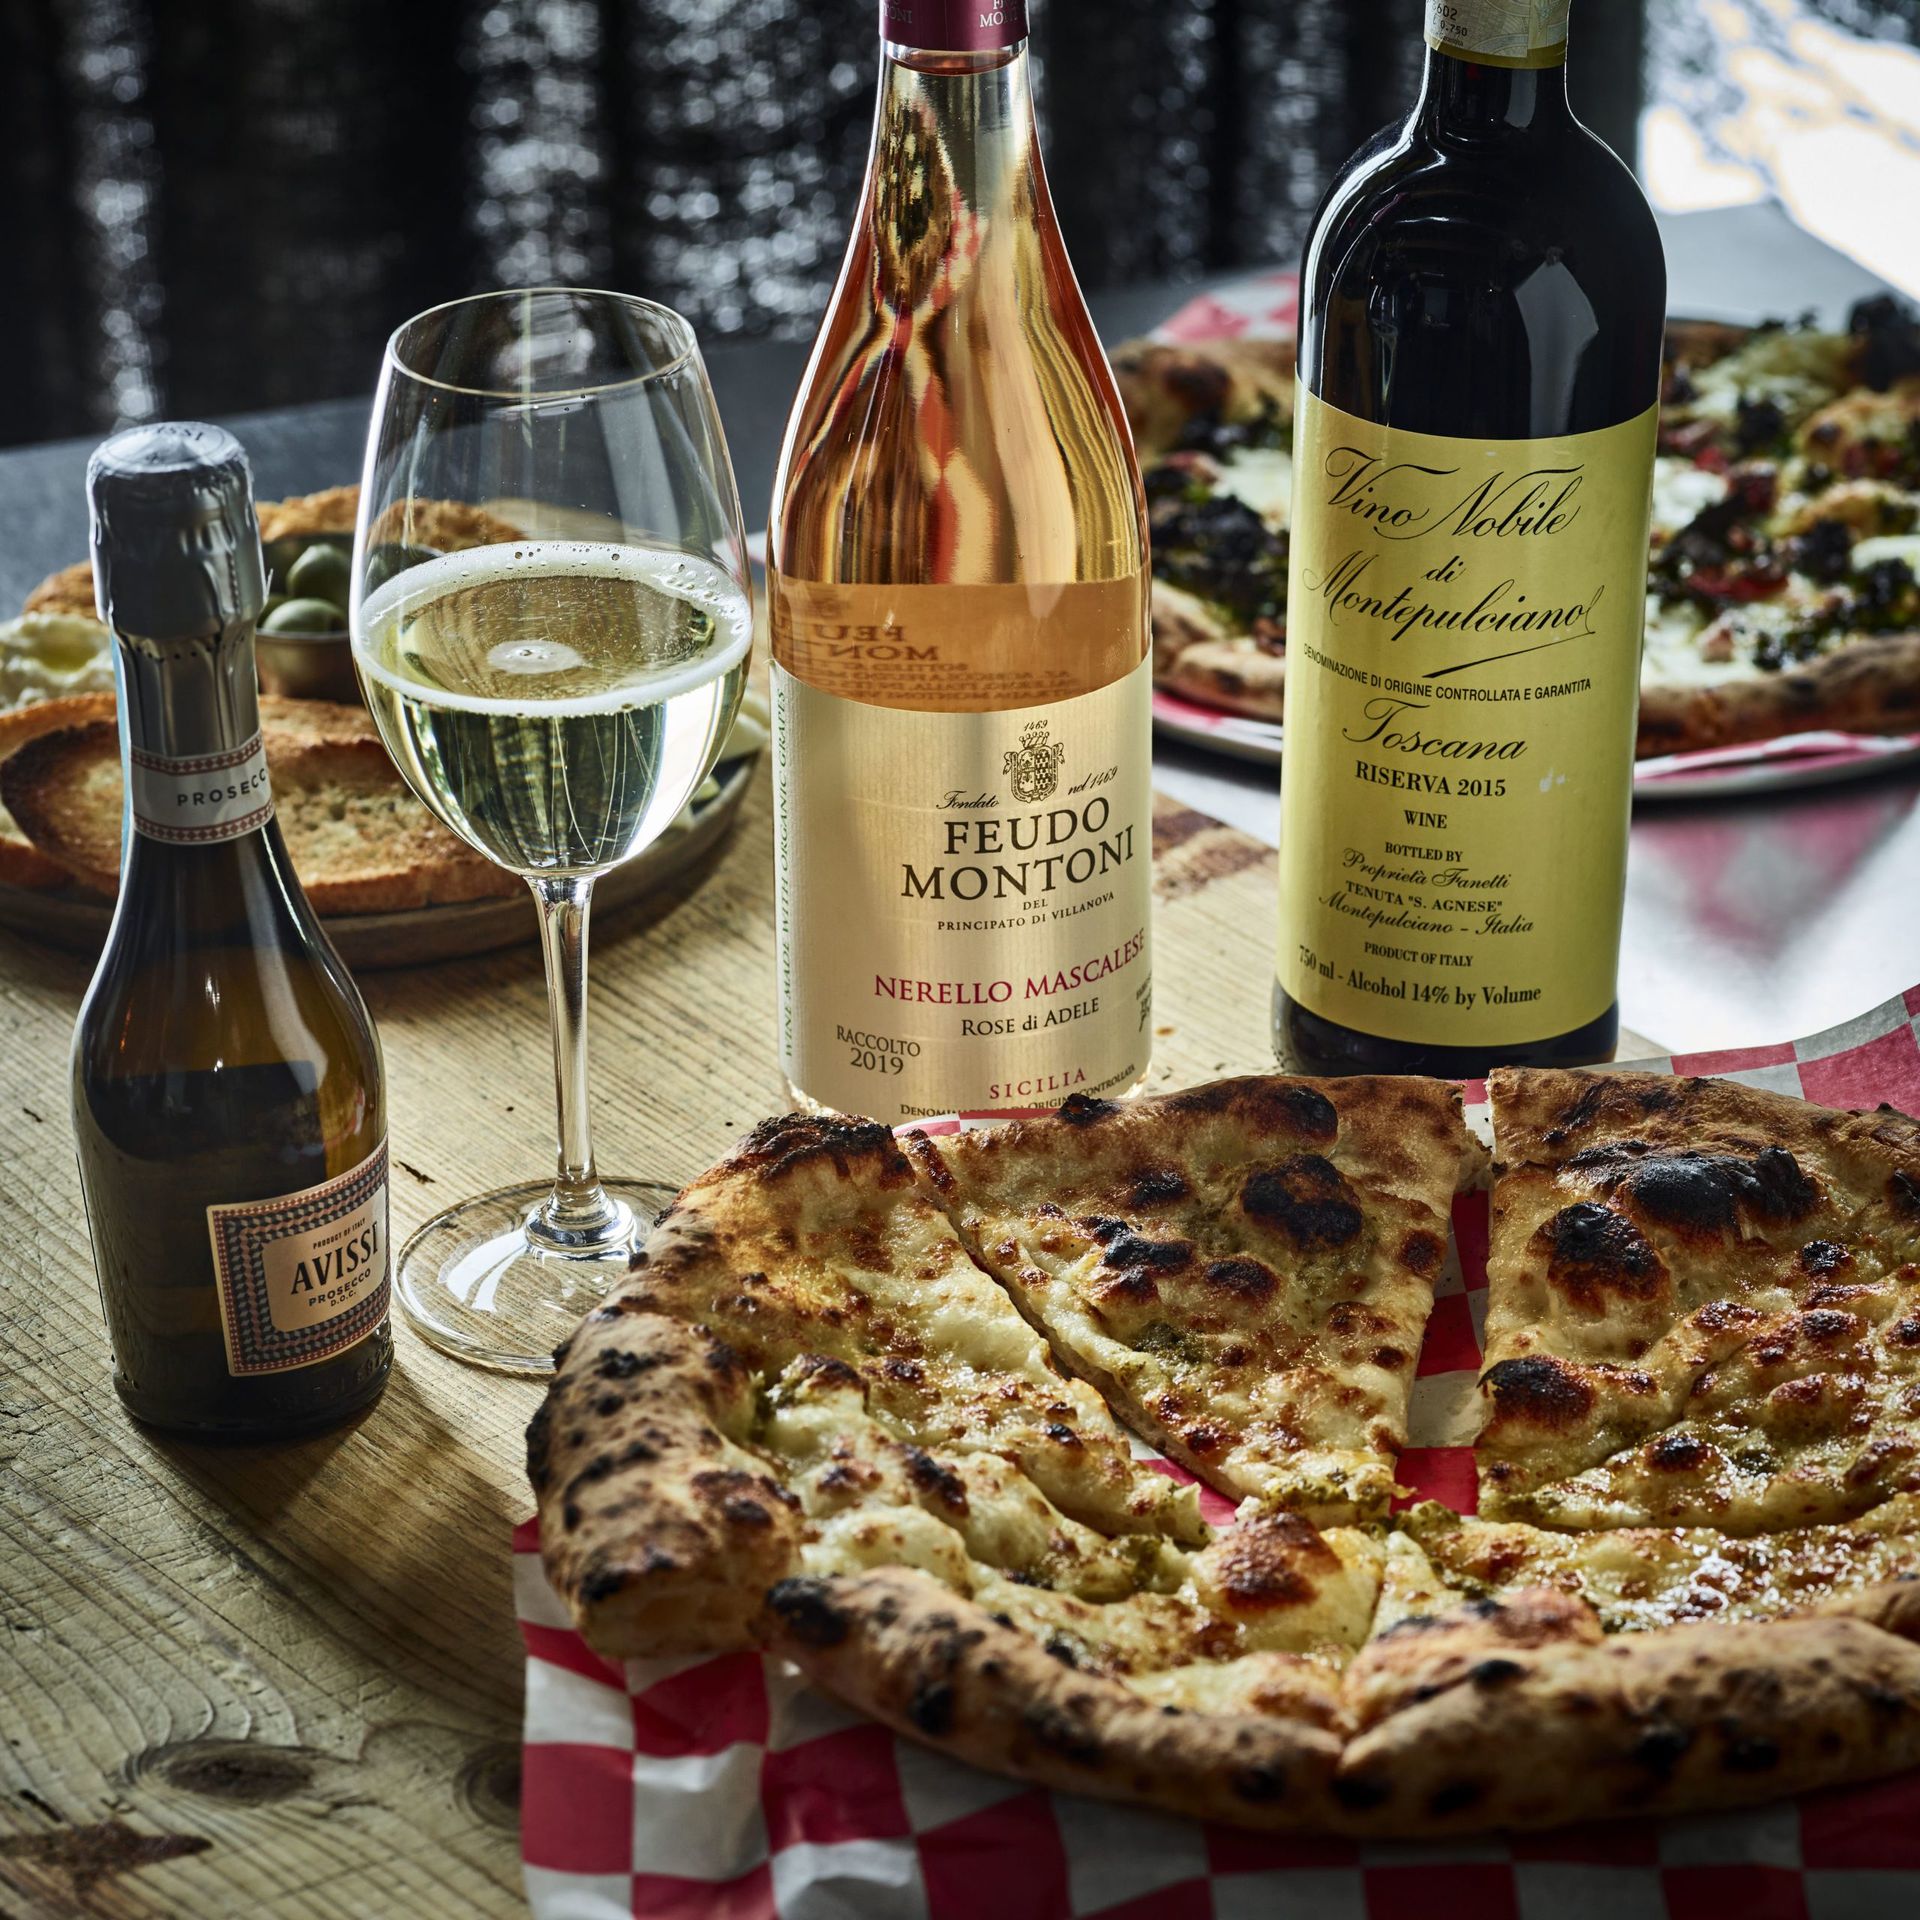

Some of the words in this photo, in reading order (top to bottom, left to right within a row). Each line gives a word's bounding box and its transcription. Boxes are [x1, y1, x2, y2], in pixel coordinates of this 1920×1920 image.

[1325, 447, 1461, 528] Vino
[1374, 463, 1585, 540] Nobile
[1421, 555, 1466, 583] di
[1303, 551, 1605, 642] Montepulciano
[1303, 643, 1368, 685] DENOMINAZIONE
[1370, 674, 1382, 688] DI
[1384, 678, 1432, 698] ORIGINE
[1435, 687, 1521, 701] CONTROLLATA
[1523, 688, 1531, 701] E
[1535, 678, 1592, 699] GARANTITA
[777, 688, 787, 768] GRAPES
[1023, 719, 1049, 732] 1469
[1341, 697, 1529, 760] Toscana
[176, 768, 267, 807] PROSECC
[935, 790, 1001, 810] Fondato
[1090, 765, 1119, 790] 1469
[1355, 760, 1452, 796] RISERVA
[1458, 778, 1507, 797] 2015
[779, 771, 789, 873] ORGANIC
[943, 796, 1110, 855] FEUDO
[1403, 810, 1448, 829] WINE
[900, 824, 1134, 901] MONTONI
[1384, 841, 1443, 861] BOTTLED
[1446, 850, 1464, 862] BY
[1345, 880, 1404, 906] TENUTA
[1408, 895, 1427, 910] "S.
[1431, 899, 1503, 913] AGNESE"
[1431, 867, 1512, 889] Fanetti
[781, 876, 790, 933] WITH
[937, 917, 1026, 931] PRINCIPATO
[1031, 913, 1047, 925] DI
[1051, 890, 1115, 919] VILLANOVA
[1022, 898, 1049, 911] DEL
[1318, 890, 1454, 933] Montepulciano
[1474, 913, 1534, 935] Italia
[783, 942, 791, 1000] MADE
[873, 974, 1013, 1005] NERELLO
[1023, 928, 1145, 999] MASCALESE
[1363, 941, 1418, 962] PRODUCT
[1420, 952, 1437, 964] OF
[1439, 955, 1474, 967] ITALY
[1299, 945, 1317, 971] 750
[1319, 961, 1335, 980] ml
[1346, 969, 1406, 999] Alcohol
[1412, 983, 1450, 1004] 14%
[1455, 986, 1477, 1010] by
[1481, 986, 1542, 1005] Volume
[785, 1006, 793, 1057] WINE
[1021, 1014, 1037, 1031] di
[1044, 995, 1100, 1028] ADELE
[836, 1023, 921, 1058] RACCOLTO
[850, 1047, 905, 1076] 2019
[989, 1067, 1087, 1100] SICILIA
[312, 1232, 342, 1250] PRODUCT
[343, 1227, 351, 1237] OF
[352, 1217, 366, 1232] ITALY
[290, 1220, 378, 1296] AVISSI
[308, 1267, 371, 1307] PROSECCO
[330, 1289, 357, 1307] D.O.C.
